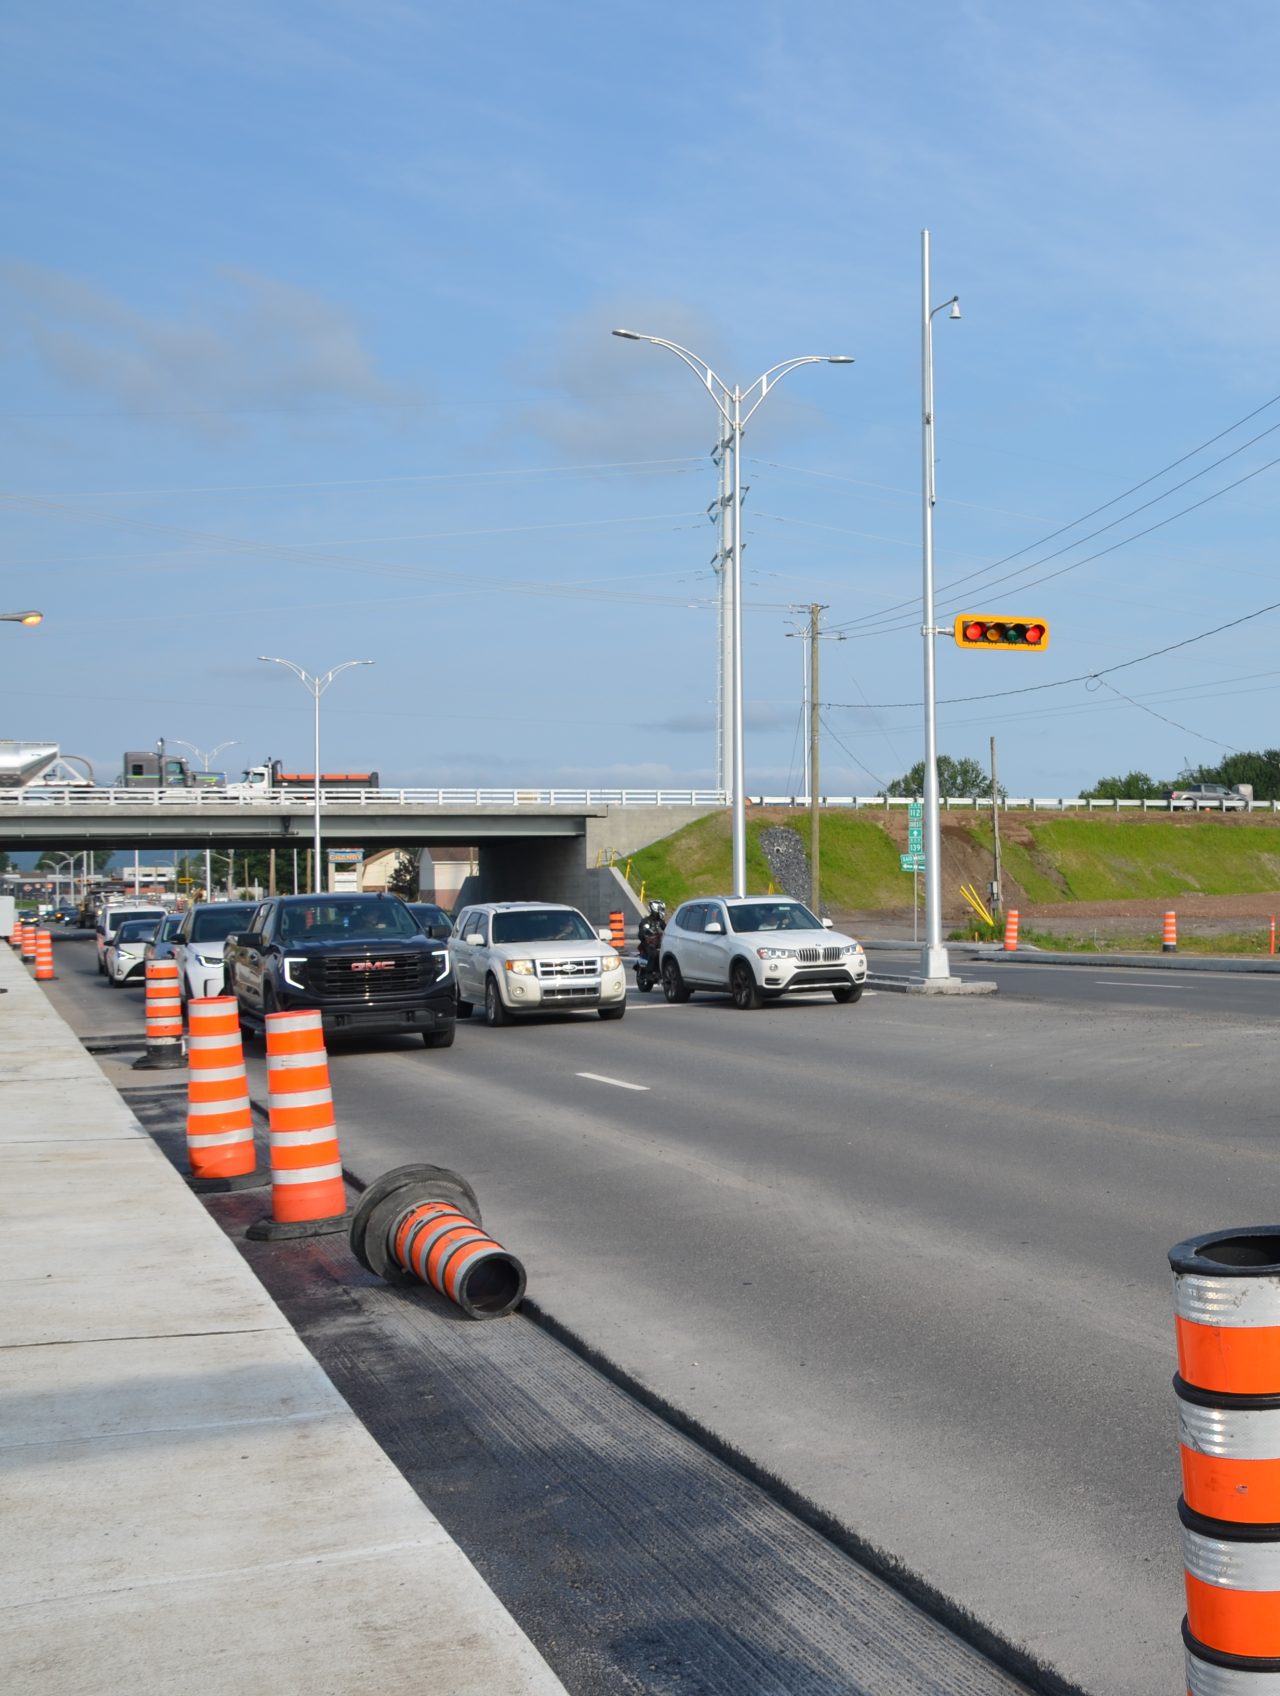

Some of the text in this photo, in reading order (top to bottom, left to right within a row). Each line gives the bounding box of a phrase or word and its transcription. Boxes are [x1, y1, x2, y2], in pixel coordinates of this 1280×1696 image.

[910, 809, 921, 817] 112
[910, 844, 921, 852] 139
[351, 960, 396, 971] GMC
